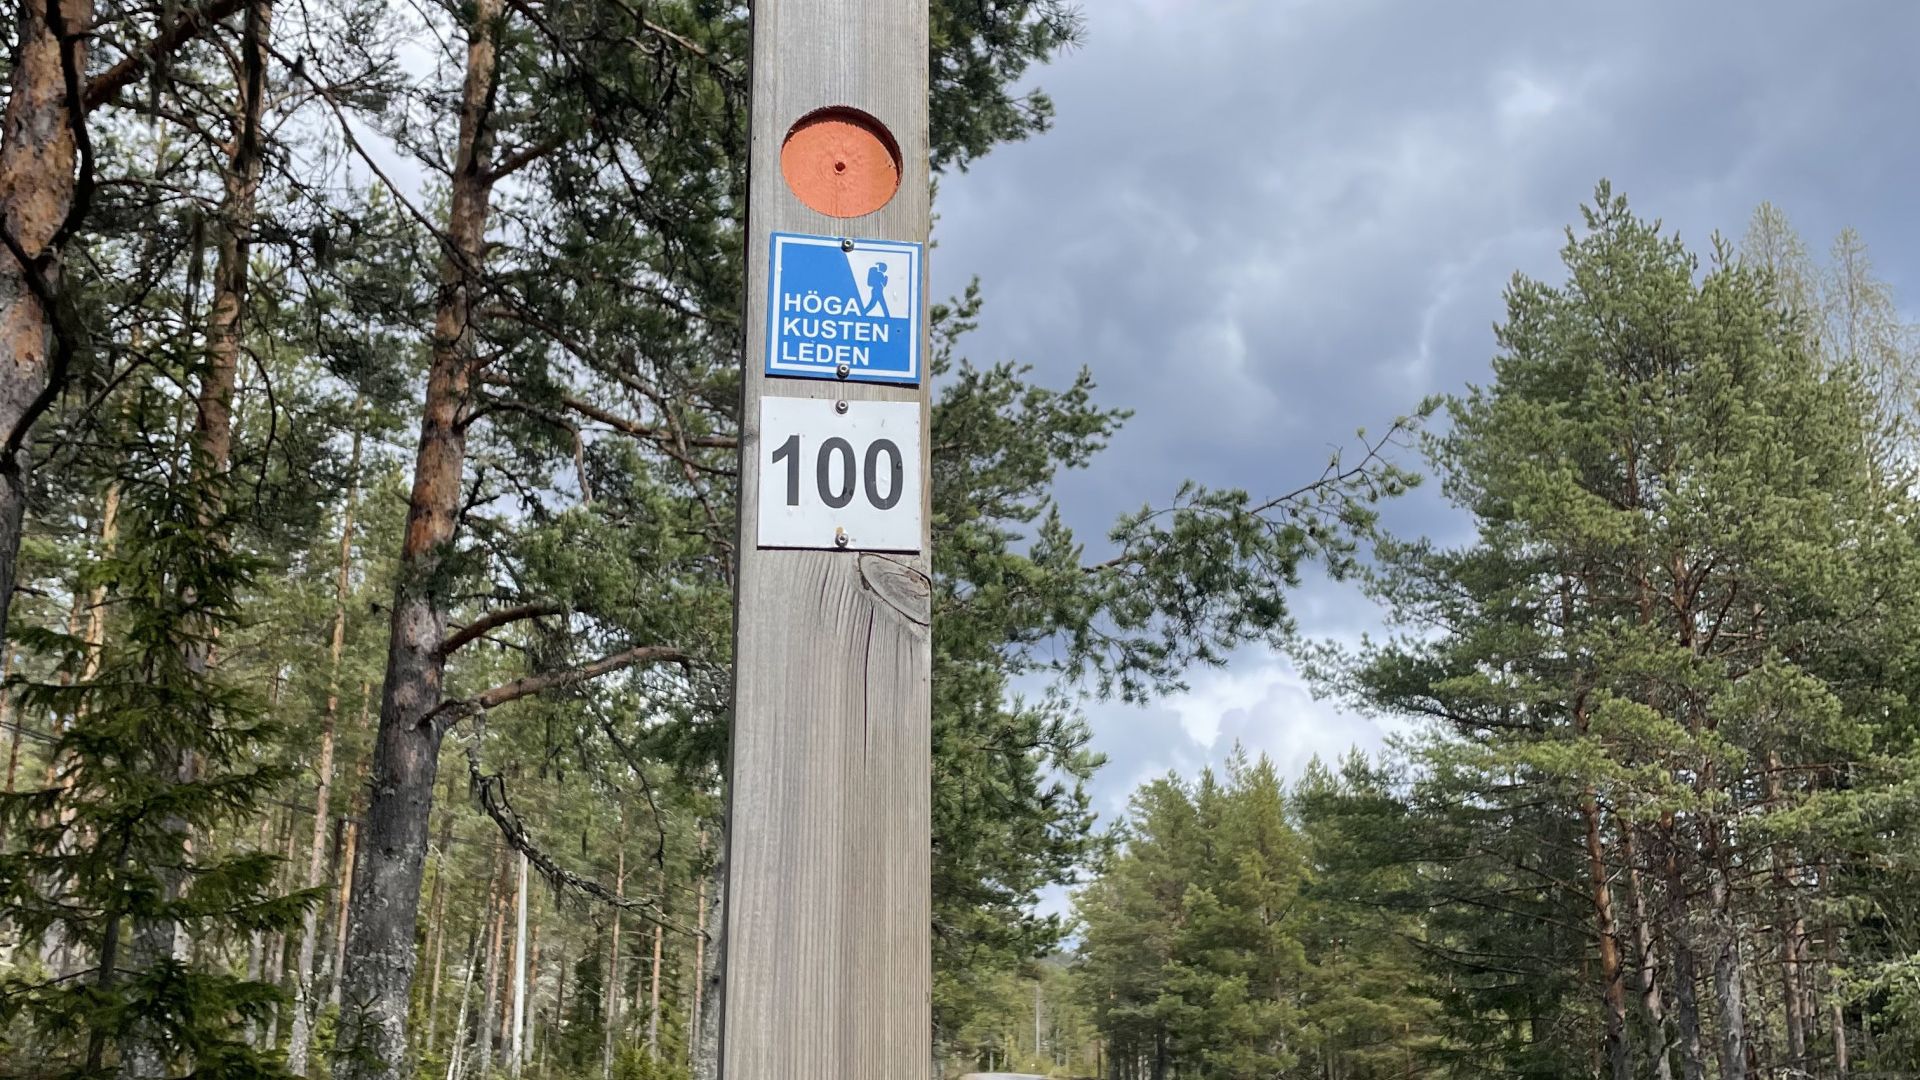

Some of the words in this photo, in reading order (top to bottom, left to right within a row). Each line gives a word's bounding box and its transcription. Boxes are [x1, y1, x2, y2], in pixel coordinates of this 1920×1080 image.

[784, 290, 862, 316] HÖGA
[783, 317, 889, 343] KUSTEN
[782, 341, 870, 366] LEDEN
[772, 435, 903, 510] 100
